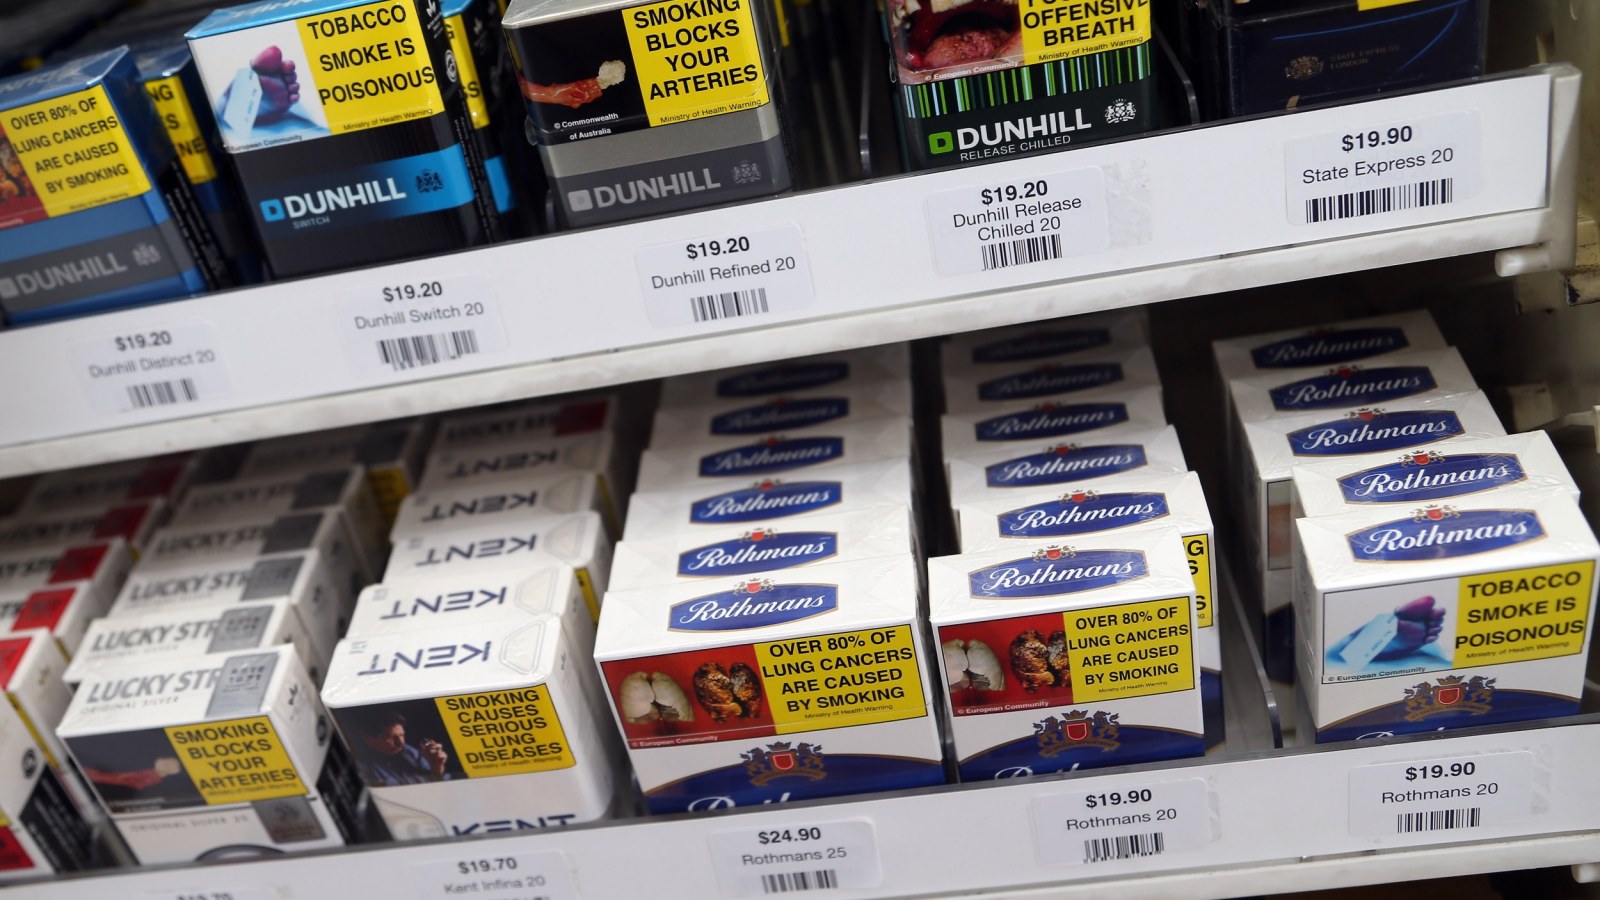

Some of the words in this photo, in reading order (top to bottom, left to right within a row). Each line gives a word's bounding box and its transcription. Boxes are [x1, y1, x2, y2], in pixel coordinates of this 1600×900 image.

[307, 3, 407, 40] TOBACCO
[633, 0, 741, 29] SMOKING
[646, 19, 740, 51] BLOCKS
[1043, 16, 1135, 46] BREATH
[319, 41, 392, 72] SMOKE
[398, 38, 416, 57] IS
[665, 46, 729, 72] YOUR
[1039, 51, 1070, 60] Ministry
[1082, 44, 1108, 53] Health
[1111, 36, 1143, 47] Warning
[933, 70, 971, 80] European
[973, 61, 1019, 73] Community
[1330, 57, 1370, 70] LONDON
[318, 65, 435, 106] POISONOUS
[650, 64, 758, 100] ARTERIES
[11, 109, 48, 131] OVER
[50, 104, 77, 121] 80%
[80, 97, 98, 112] OF
[562, 112, 619, 128] Commonwealth
[660, 113, 690, 123] Ministry
[702, 106, 727, 116] Health
[729, 99, 762, 110] Warning
[13, 136, 51, 154] LUNG
[53, 116, 118, 143] CANCERS
[570, 132, 577, 140] of
[579, 127, 612, 139] Australia
[957, 108, 1092, 150] DUNHILL
[1342, 126, 1412, 152] $19.90
[35, 155, 60, 173] ARE
[64, 142, 119, 165] CAUSED
[960, 145, 1015, 161] RELEASE
[1020, 135, 1071, 151] CHILLED
[46, 178, 64, 193] BY
[69, 163, 129, 189] SMOKING
[1302, 168, 1349, 184] State
[1355, 155, 1426, 177] Express
[1432, 148, 1454, 164] 20
[284, 177, 406, 218] DUNHILL
[595, 169, 720, 208] DUNHILL
[981, 180, 1048, 205] $19.20
[953, 207, 1010, 228] Dunhill
[1016, 197, 1082, 218] Release
[977, 222, 1034, 242] Chilled
[1040, 216, 1061, 230] 20
[686, 236, 750, 260] $19.20
[16, 253, 127, 295] DUNHILL
[651, 270, 705, 289] Dunhill
[710, 261, 771, 281] Refined
[775, 256, 796, 271] 20
[383, 281, 443, 303] $19.20
[355, 311, 406, 330] Dunhill
[409, 303, 461, 324] Switch
[464, 302, 484, 316] 20
[115, 331, 171, 352] $19.20
[89, 362, 136, 379] Dunhill
[139, 352, 194, 371] Distinct
[196, 350, 215, 363] 20
[1284, 373, 1421, 405] Rothmans
[991, 410, 1115, 436] Rothmans
[1302, 418, 1447, 450] Rothmans
[712, 444, 832, 474] Rothmans
[1001, 449, 1135, 481] Rothmans
[1354, 464, 1509, 497] Rothmans
[421, 492, 537, 522] KENT
[707, 488, 829, 517] Rothmans
[1010, 500, 1155, 531] Rothmans
[1364, 519, 1529, 554] Rothmans
[415, 534, 537, 567] KENT
[688, 540, 827, 570] Rothmans
[981, 559, 1133, 591] Rothmans
[1468, 571, 1582, 598] TOBACCO
[130, 577, 208, 601] LUCKY
[380, 586, 507, 620] KENT
[680, 593, 825, 624] Rothmans
[1468, 601, 1548, 623] SMOKE
[1555, 597, 1576, 612] IS
[1075, 612, 1118, 630] OVER
[1123, 609, 1153, 624] 80%
[1157, 606, 1178, 620] OF
[91, 628, 184, 653] LUCKY
[769, 639, 821, 658] OVER
[828, 635, 865, 650] 80%
[870, 630, 897, 644] OF
[1068, 633, 1110, 652] LUNG
[1115, 624, 1189, 645] CANCERS
[1455, 619, 1584, 650] POISONOUS
[357, 641, 492, 676] KENT
[762, 655, 815, 679] LUNG
[819, 647, 913, 670] CANCERS
[1082, 652, 1108, 668] ARE
[1116, 644, 1179, 664] CAUSED
[1466, 651, 1496, 659] Ministry
[781, 673, 820, 695] ARE
[823, 667, 902, 691] CAUSED
[1084, 669, 1104, 685] BY
[1108, 663, 1179, 682] SMOKING
[1337, 673, 1377, 682] European
[1379, 667, 1426, 677] Community
[86, 677, 184, 704] LUCKY
[445, 689, 540, 711] SMOKING
[787, 696, 811, 713] BY
[821, 686, 905, 710] SMOKING
[457, 704, 540, 724] CAUSES
[865, 704, 893, 712] Warning
[966, 706, 1003, 714] European
[1004, 701, 1049, 711] Community
[173, 722, 269, 745] SMOKING
[459, 717, 548, 737] SERIOUS
[187, 739, 273, 760] BLOCKS
[465, 743, 563, 764] DISEASES
[480, 733, 536, 750] LUNG
[208, 756, 268, 774] YOUR
[1405, 761, 1476, 781] $19.90
[199, 768, 297, 790] ARTERIES
[1085, 789, 1152, 809] $19.90
[1382, 786, 1471, 804] Rothmans
[1477, 782, 1499, 796] 20
[1066, 812, 1151, 831] Rothmans
[1156, 808, 1177, 821] 20
[758, 827, 821, 845] $24.90
[458, 858, 517, 875] $19.70
[741, 850, 822, 867] Rothmans
[827, 846, 847, 859] 25
[444, 882, 478, 895] Kent
[482, 879, 518, 893] Infina
[522, 876, 546, 888] 20
